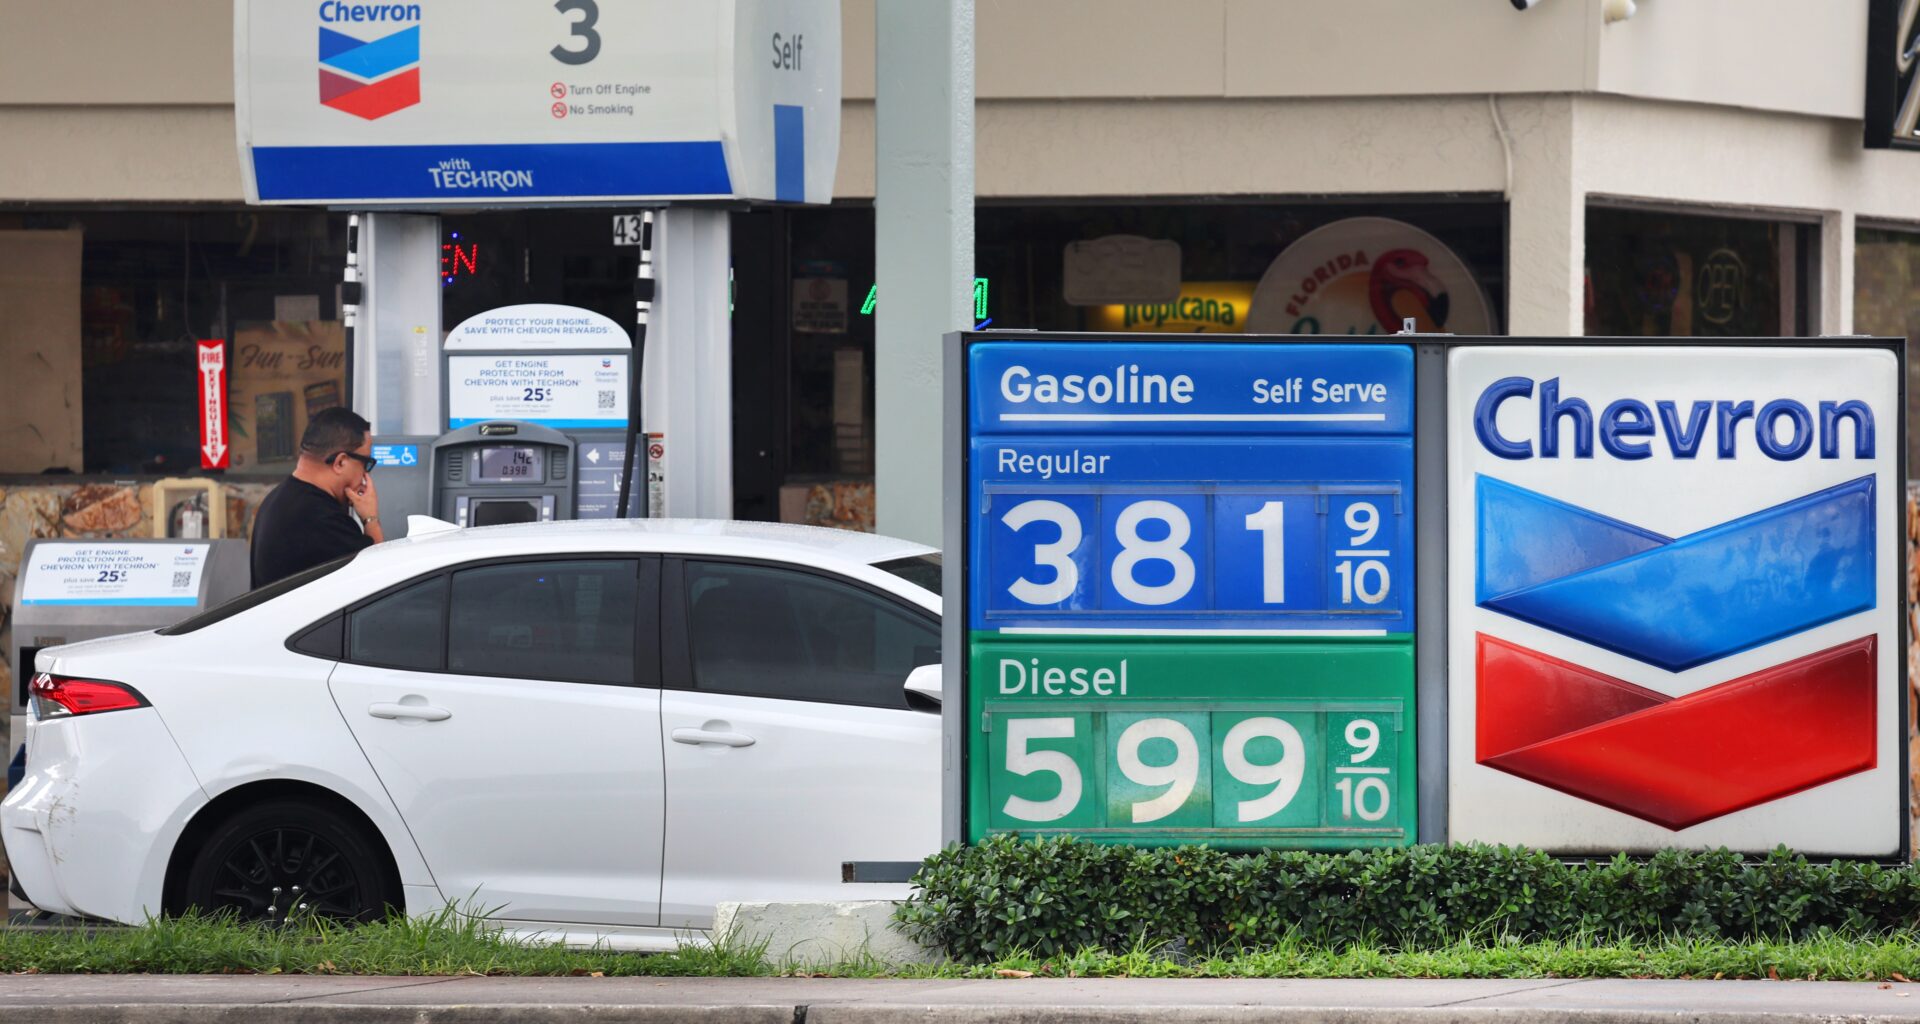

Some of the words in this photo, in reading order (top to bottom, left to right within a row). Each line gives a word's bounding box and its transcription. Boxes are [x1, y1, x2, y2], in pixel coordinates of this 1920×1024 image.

[319, 0, 421, 22] Chevron
[550, 0, 602, 66] 3
[772, 32, 803, 71] Self
[570, 85, 593, 96] Turn
[596, 84, 612, 96] Off
[615, 84, 652, 97] Engine
[570, 105, 584, 115] No
[587, 103, 634, 116] Smoking
[428, 168, 532, 191] TECHRON
[439, 158, 471, 170] with
[1285, 249, 1371, 317] FLORIDA
[464, 327, 488, 335] SAVE
[516, 326, 560, 335] CHEVRON
[485, 318, 527, 326] PROTECT
[529, 318, 554, 326] YOUR
[201, 352, 221, 364] FIRE
[241, 343, 284, 369] Fun
[298, 344, 345, 370] Sun
[515, 360, 549, 368] ENGINE
[1001, 364, 1194, 404] Gasoline
[1252, 378, 1302, 403] Self
[1312, 378, 1387, 403] Serve
[208, 369, 218, 458] EXTINGUISHER
[1474, 376, 1876, 462] Chevron
[998, 449, 1110, 479] Regular
[1344, 502, 1380, 546] 9
[1001, 500, 1285, 605] 381
[1336, 560, 1390, 604] 10
[1000, 658, 1128, 696] Diesel
[1344, 719, 1380, 764] 9
[1002, 717, 1306, 824] 599
[1336, 777, 1390, 822] 10
